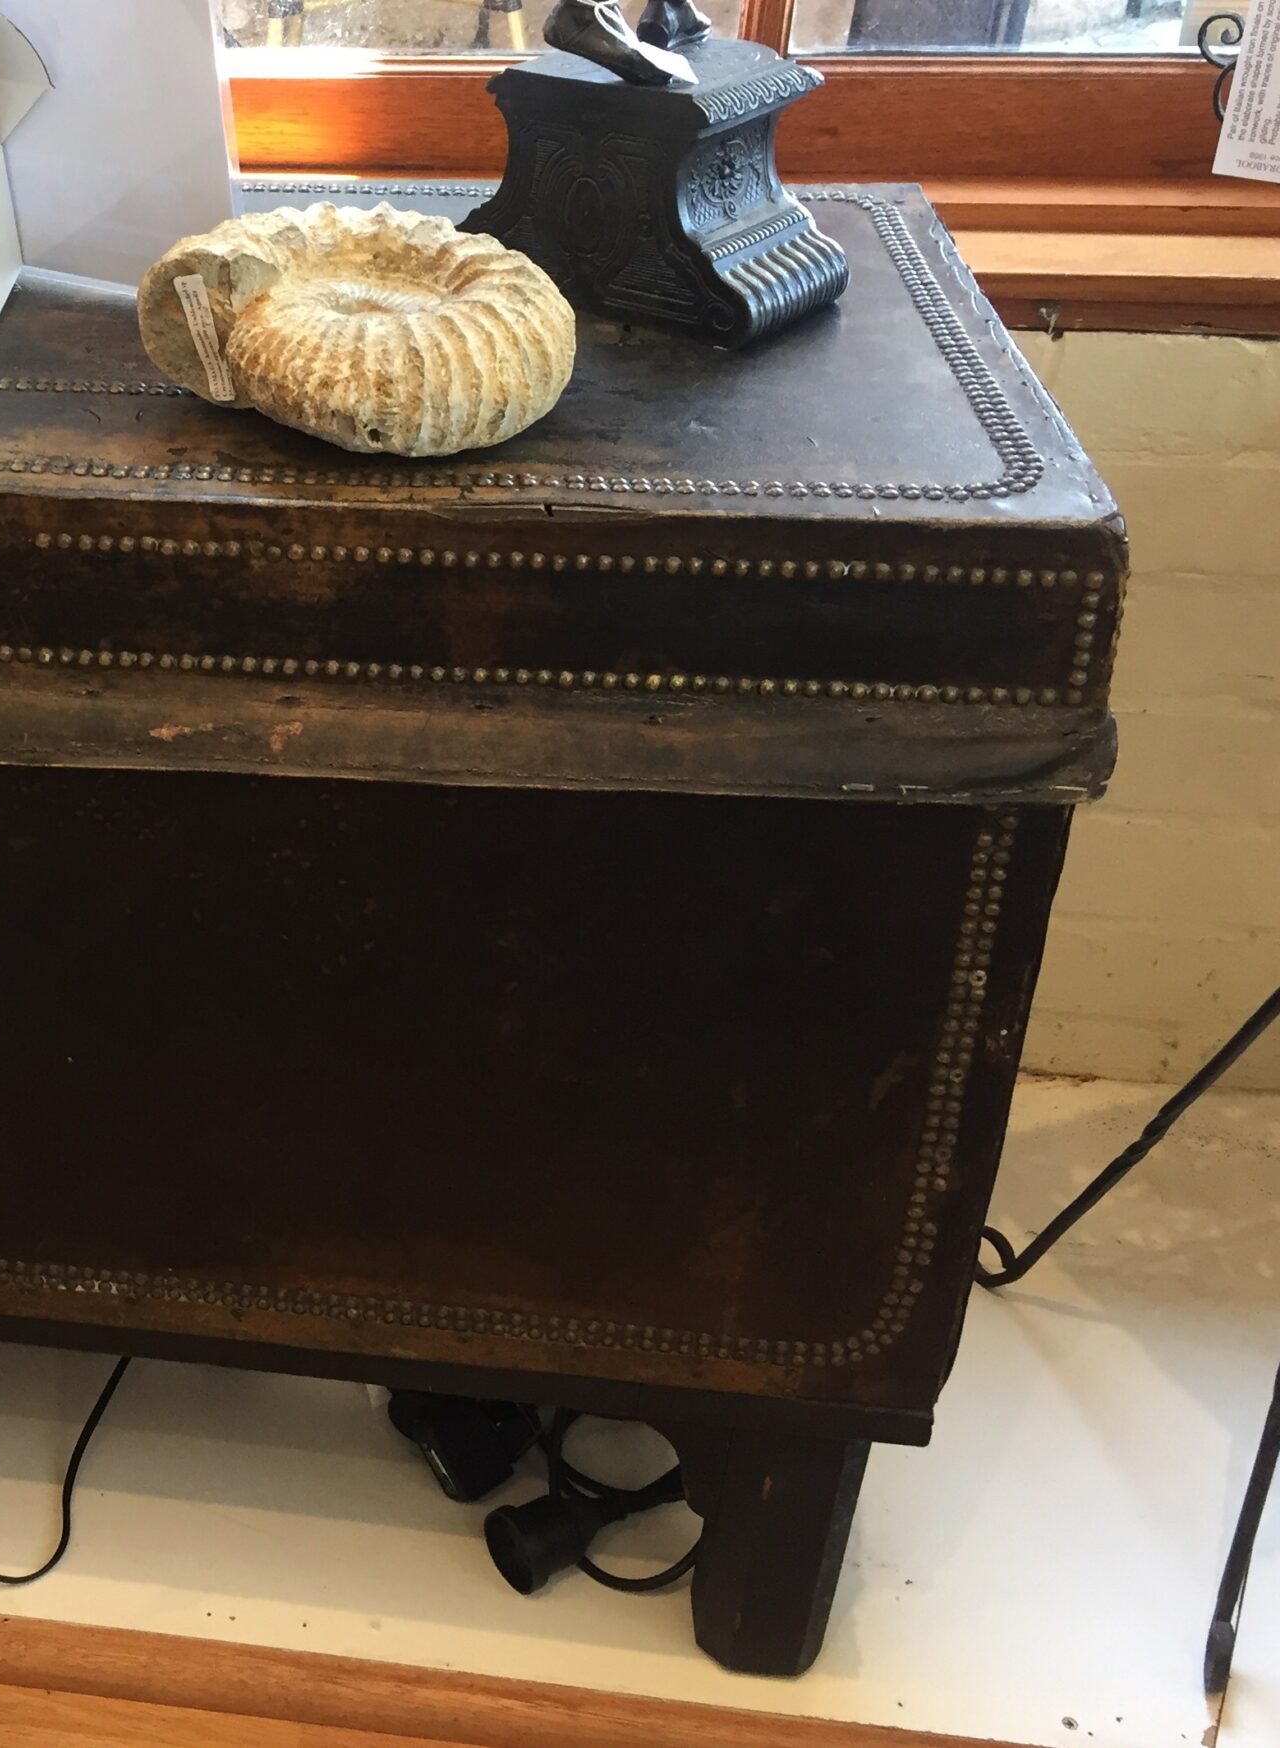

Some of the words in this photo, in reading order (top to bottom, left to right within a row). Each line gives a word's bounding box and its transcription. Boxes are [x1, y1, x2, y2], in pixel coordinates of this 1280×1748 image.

[1257, 1, 1264, 12] on
[1263, 18, 1273, 29] by
[1248, 38, 1256, 54] iron
[1256, 30, 1269, 57] formed
[1267, 53, 1274, 61] of
[1241, 55, 1252, 87] wrought
[1250, 60, 1262, 88] shapes
[1261, 63, 1272, 87] traces
[1233, 89, 1245, 112] Italian
[1258, 89, 1266, 105] with
[1242, 90, 1255, 127] elaborate
[1232, 113, 1239, 122] of
[1227, 123, 1237, 139] Pair
[1238, 128, 1247, 141] the
